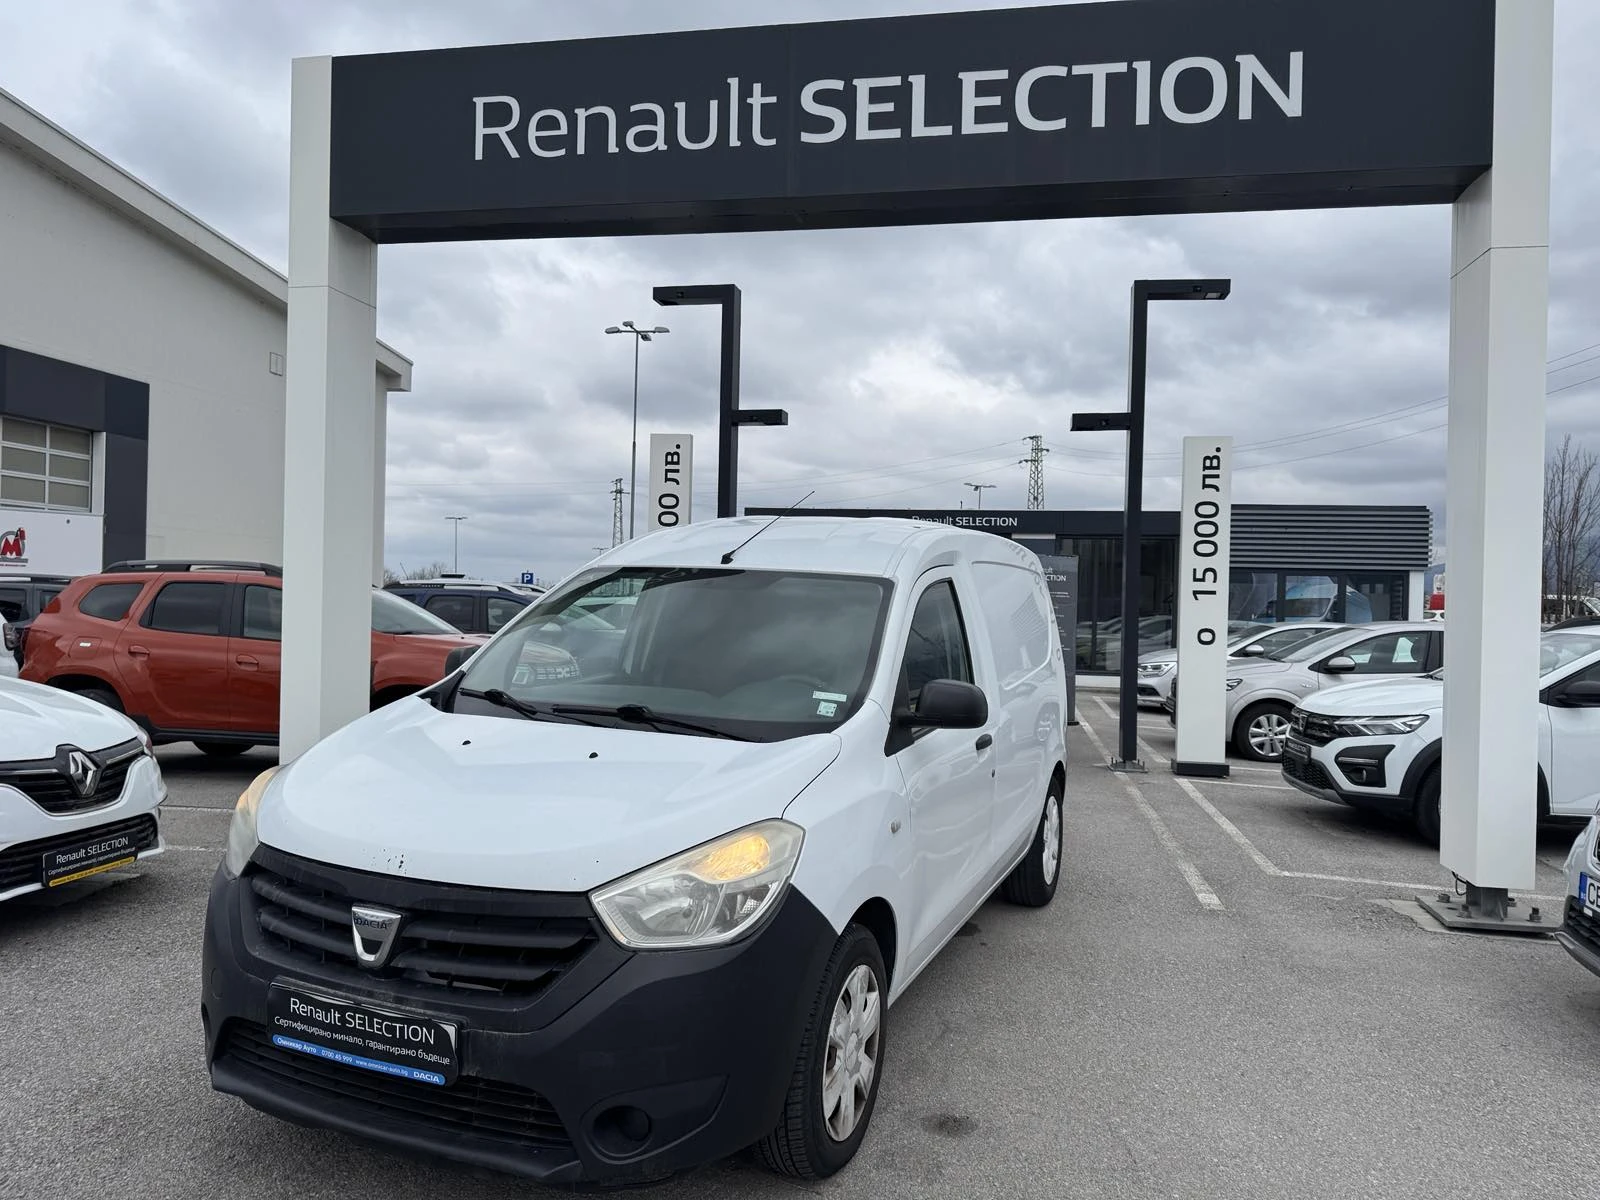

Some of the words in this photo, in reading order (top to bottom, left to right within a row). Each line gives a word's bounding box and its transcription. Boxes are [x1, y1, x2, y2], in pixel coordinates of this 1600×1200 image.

[473, 77, 777, 160] Renault
[801, 51, 1303, 143] SELECTION
[664, 444, 680, 486] лв.
[1201, 446, 1221, 492] лв.
[956, 516, 1018, 526] SELECTION
[1193, 501, 1219, 558] 000
[524, 574, 531, 583] P
[1192, 567, 1218, 600] 15
[56, 848, 86, 864] Renault
[88, 836, 128, 856] SELECTION
[354, 918, 388, 930] DACIA
[290, 997, 342, 1026] Renault
[345, 1012, 434, 1045] SELECTION
[274, 1016, 332, 1039] Сертифицирано
[332, 1032, 364, 1047] минало,
[366, 1040, 416, 1058] гарантирано
[417, 1048, 450, 1065] бъдеще
[414, 1071, 440, 1083] DACIA
